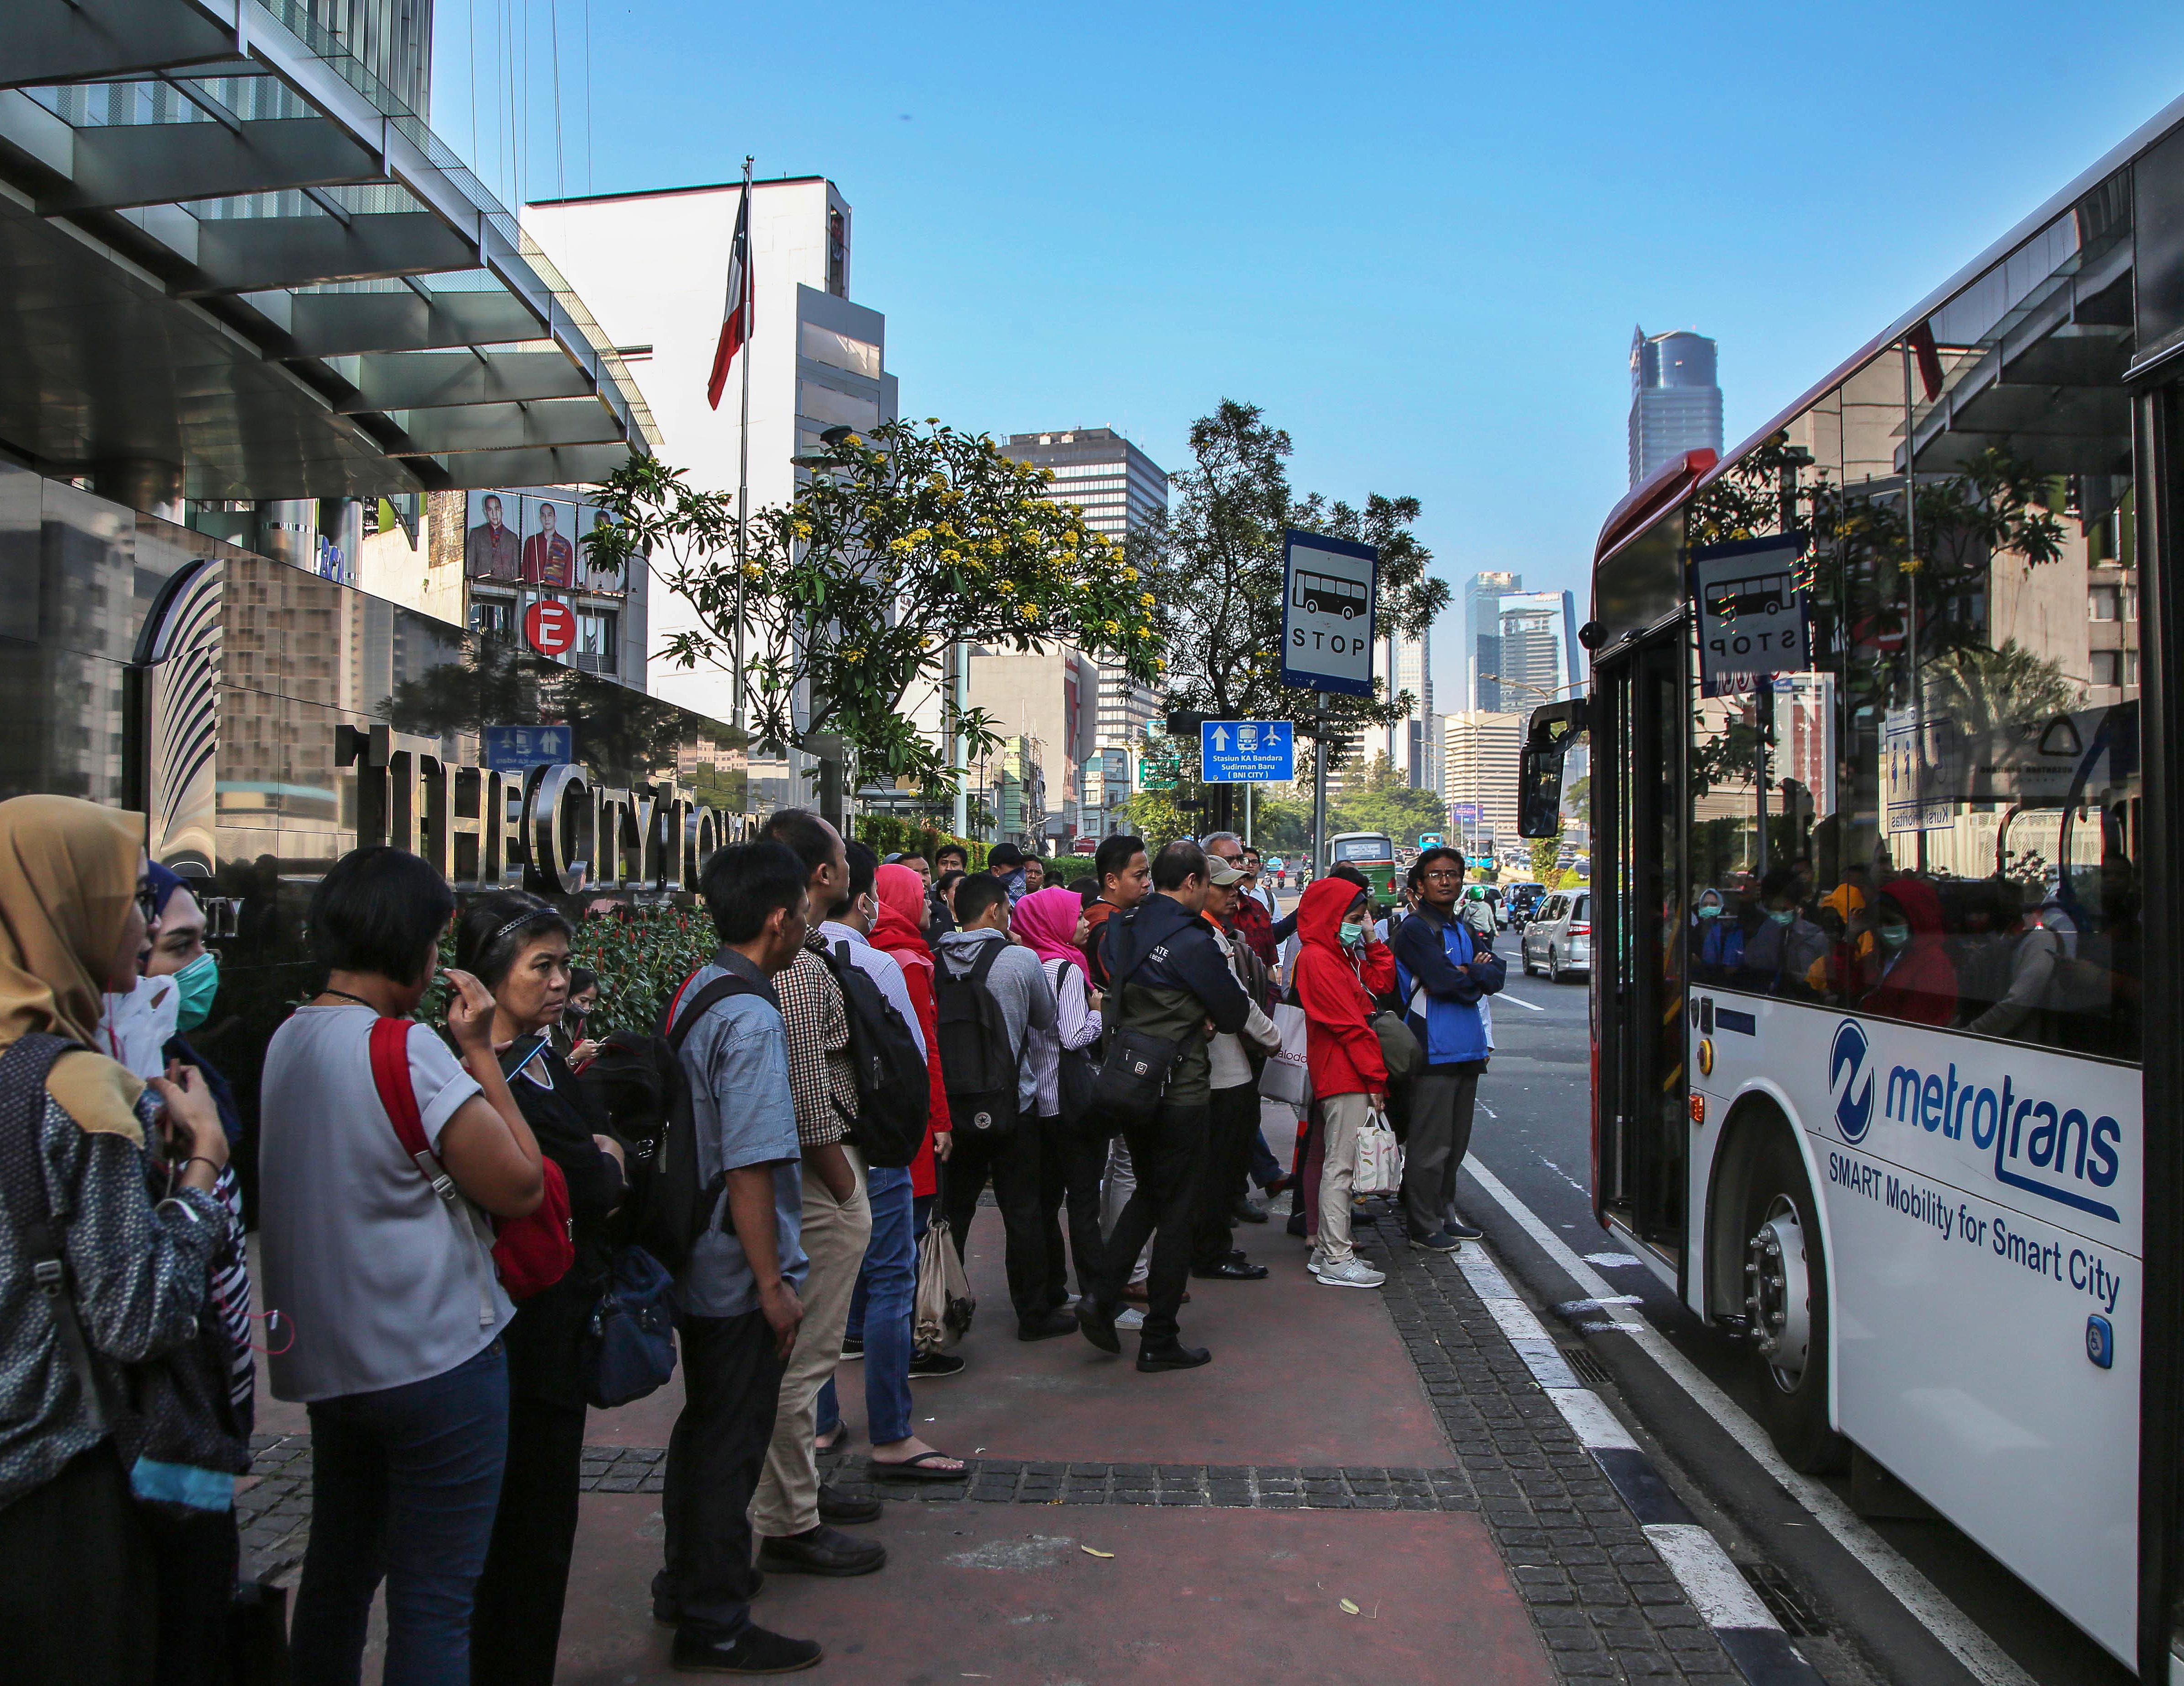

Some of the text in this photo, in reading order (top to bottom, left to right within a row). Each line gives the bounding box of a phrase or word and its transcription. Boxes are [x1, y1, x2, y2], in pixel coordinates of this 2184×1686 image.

[539, 608, 564, 646] E
[1292, 628, 1365, 656] STOP
[369, 724, 524, 893] THE
[526, 763, 657, 895] CITY
[1151, 954, 1164, 963] BEST
[1278, 1049, 1307, 1063] alodo
[1885, 1063, 2121, 1223] metrotrans
[1829, 1152, 2120, 1314] SMART Mobility for Smart City
